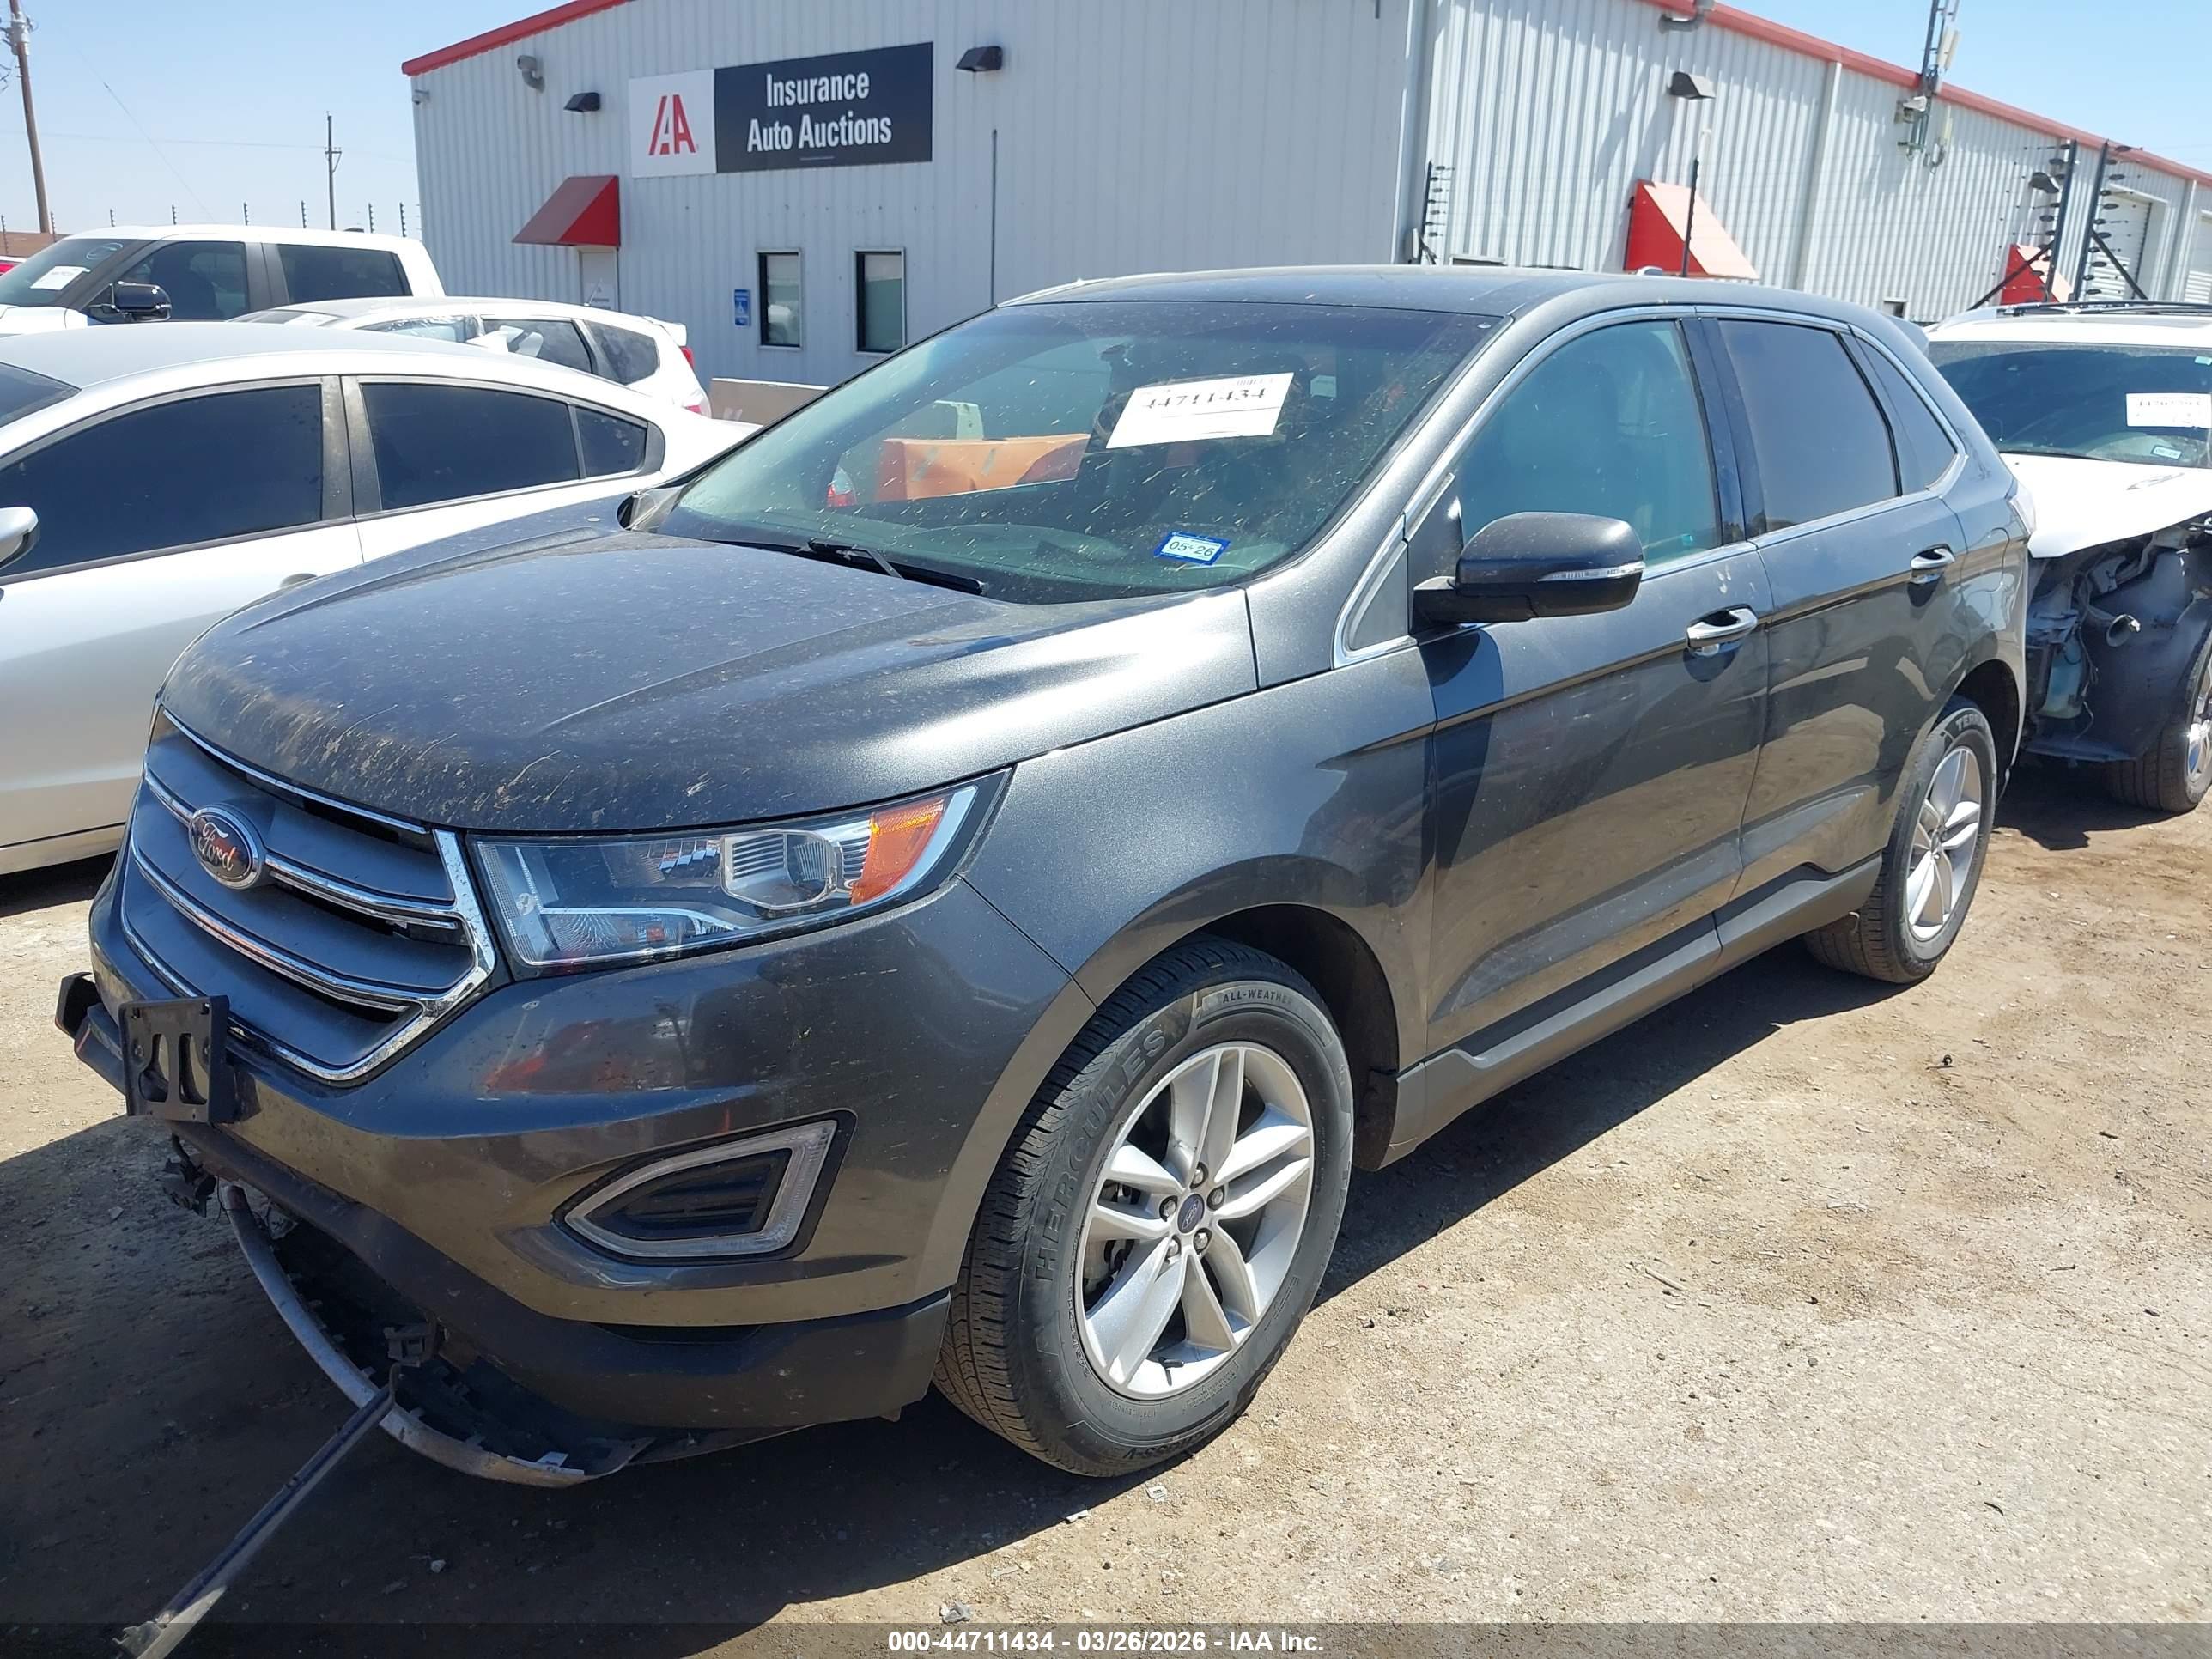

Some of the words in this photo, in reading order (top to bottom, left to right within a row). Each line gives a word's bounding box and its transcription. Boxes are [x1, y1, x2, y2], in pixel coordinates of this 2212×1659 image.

[766, 71, 870, 107] Insurance
[747, 118, 793, 153] Auto
[798, 111, 892, 149] Auctions
[198, 822, 235, 871] Ford
[1035, 1026, 1166, 1282] HERCULES
